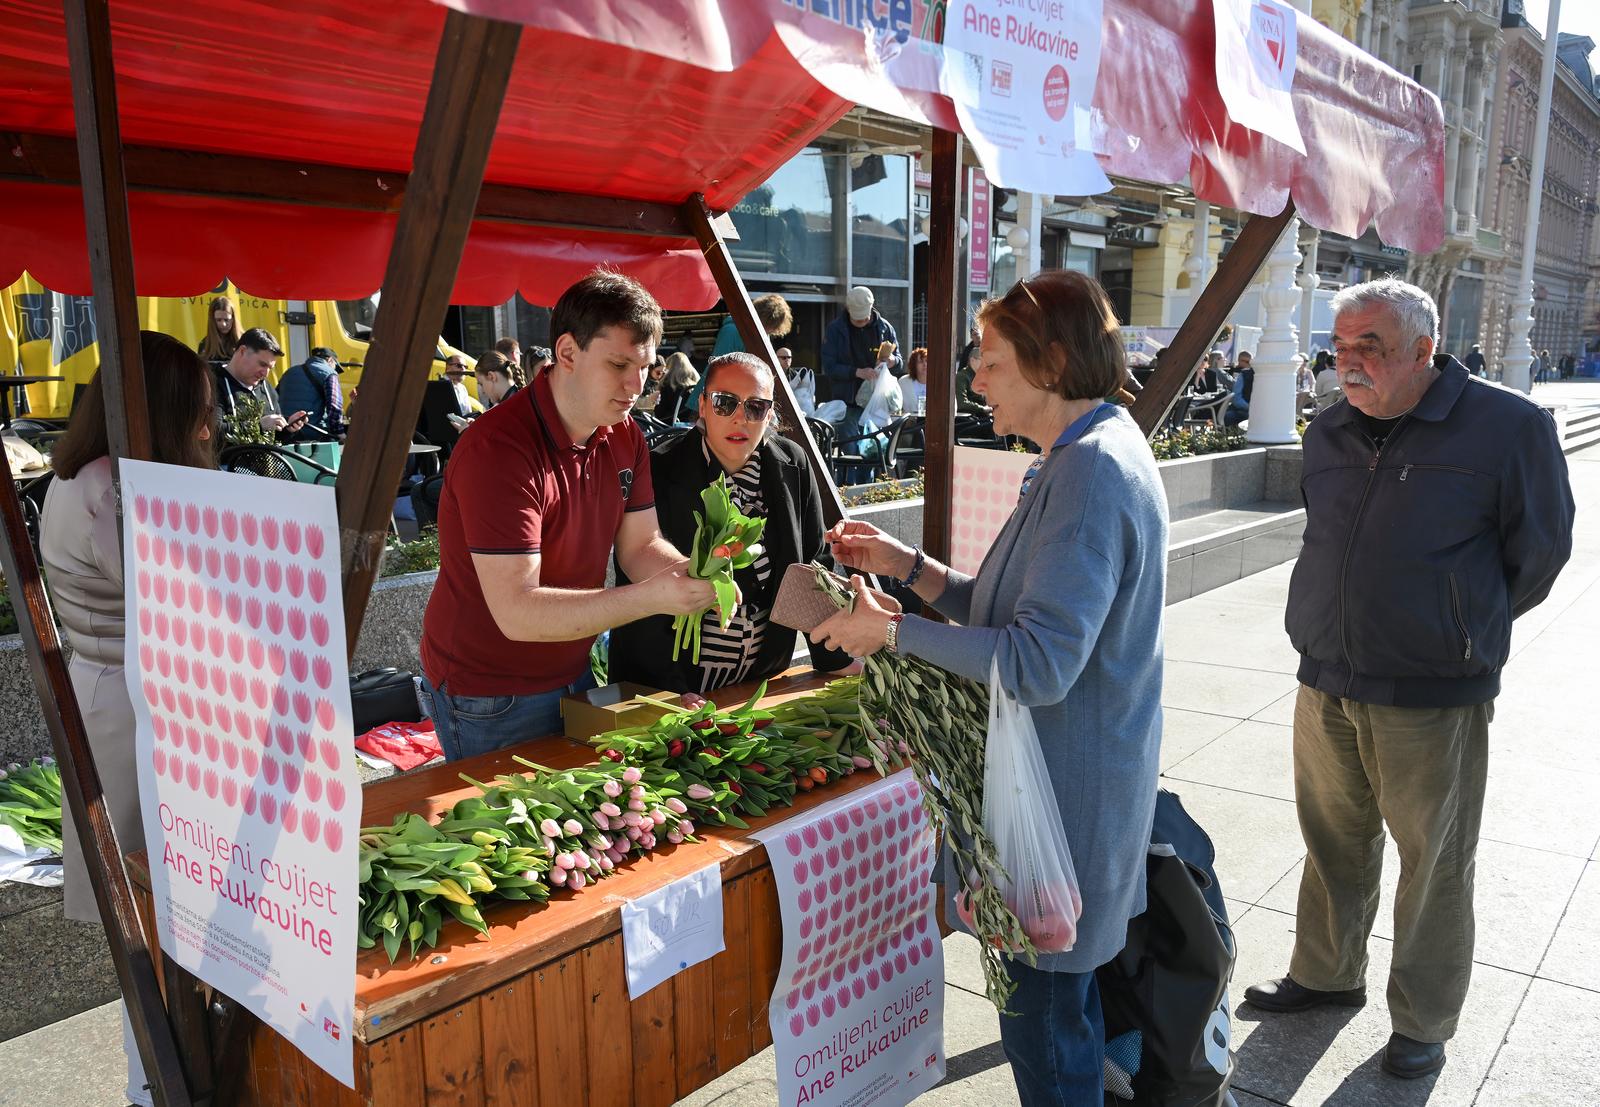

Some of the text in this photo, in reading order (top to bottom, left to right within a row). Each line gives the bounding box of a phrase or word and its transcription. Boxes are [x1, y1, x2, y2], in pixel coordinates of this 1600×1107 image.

[964, 3, 1079, 61] Ane Rukavine
[158, 803, 337, 916] Omiljeni cvijet
[163, 840, 332, 956] Ane Rukavine
[795, 978, 932, 1078] Omiljeni cvijet
[797, 1008, 929, 1107] Ane Rukavine
